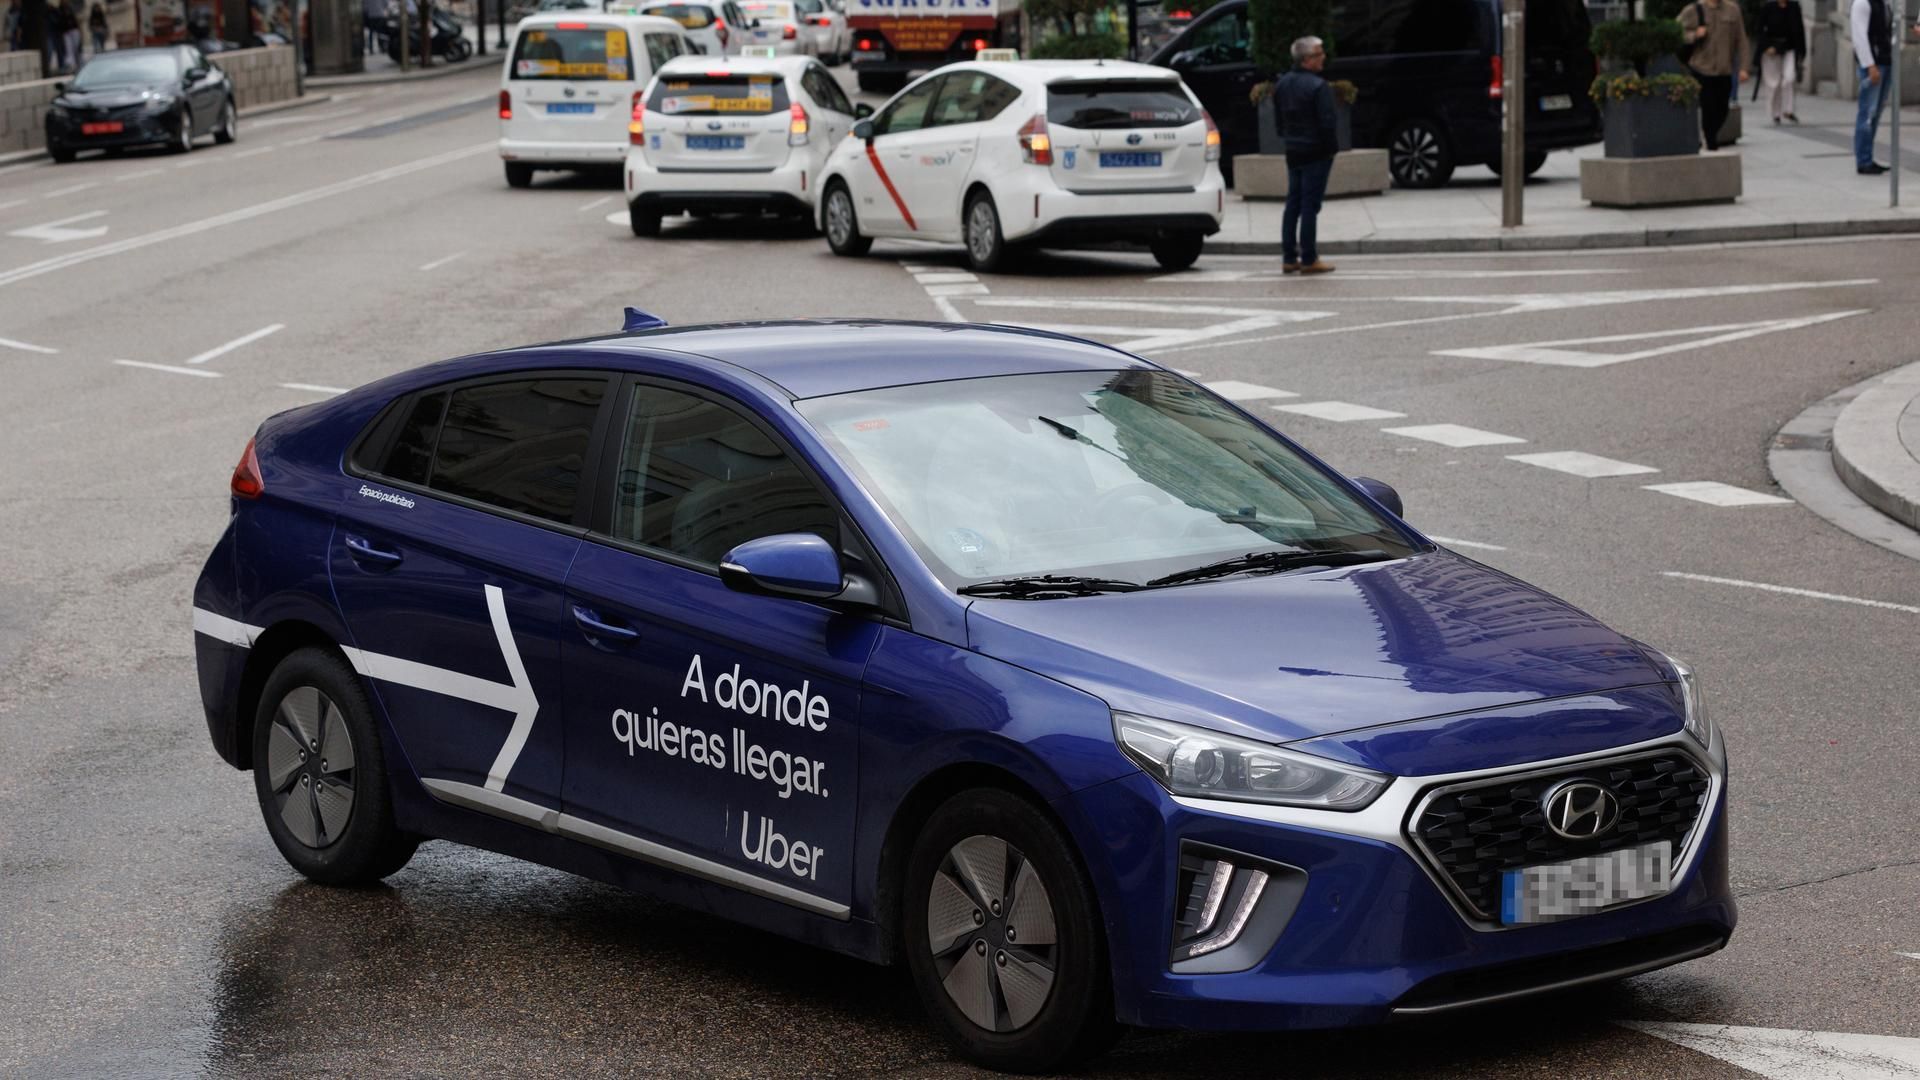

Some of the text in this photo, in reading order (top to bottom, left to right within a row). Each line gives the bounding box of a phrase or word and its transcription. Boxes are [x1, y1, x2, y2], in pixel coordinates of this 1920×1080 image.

[359, 485, 415, 508] Espacio publicitario
[681, 654, 830, 732] A donde
[611, 706, 829, 799] quieras llegar.
[740, 810, 824, 881] Uber
